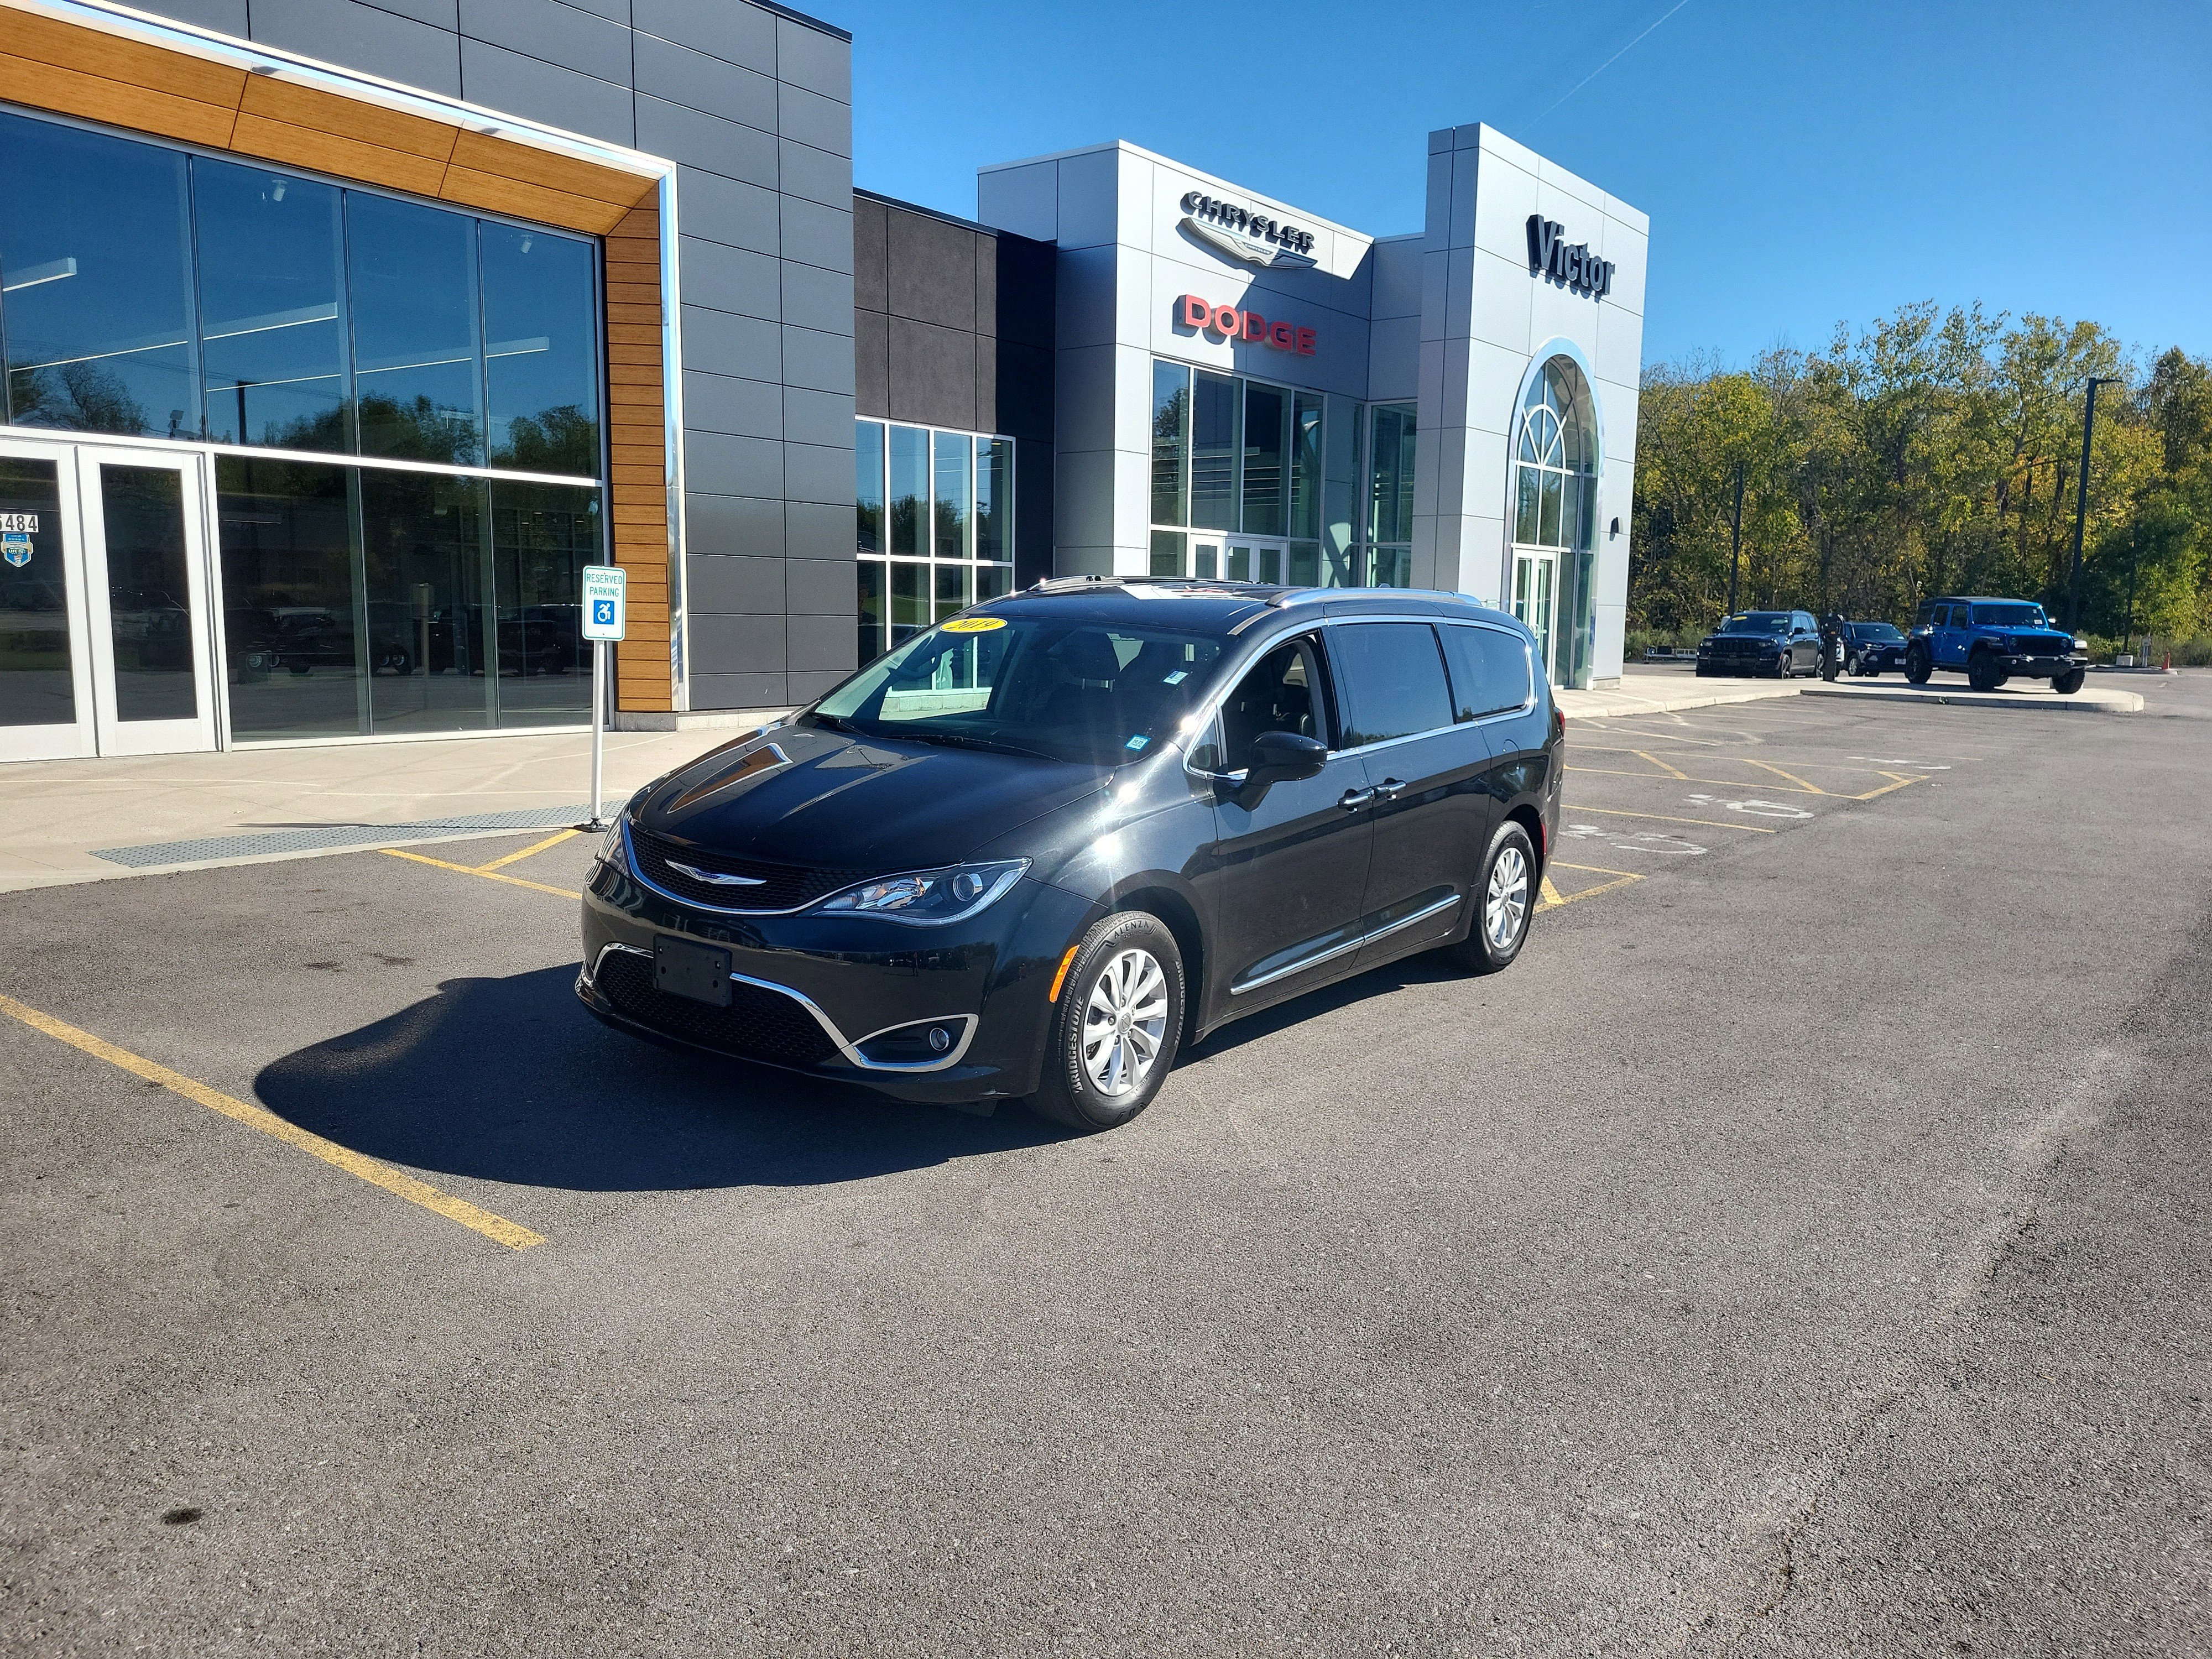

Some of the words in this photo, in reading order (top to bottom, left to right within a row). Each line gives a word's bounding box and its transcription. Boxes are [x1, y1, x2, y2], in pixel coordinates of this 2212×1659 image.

[1187, 191, 1315, 250] CHRYSLER
[1535, 214, 1616, 295] Victor
[1185, 294, 1317, 356] DODGE
[586, 573, 623, 585] RESERVED
[589, 587, 619, 597] PARKING
[946, 620, 999, 629] 2019
[1114, 920, 1149, 940] ALENZA
[1068, 996, 1085, 1094] BRIDGESTONE
